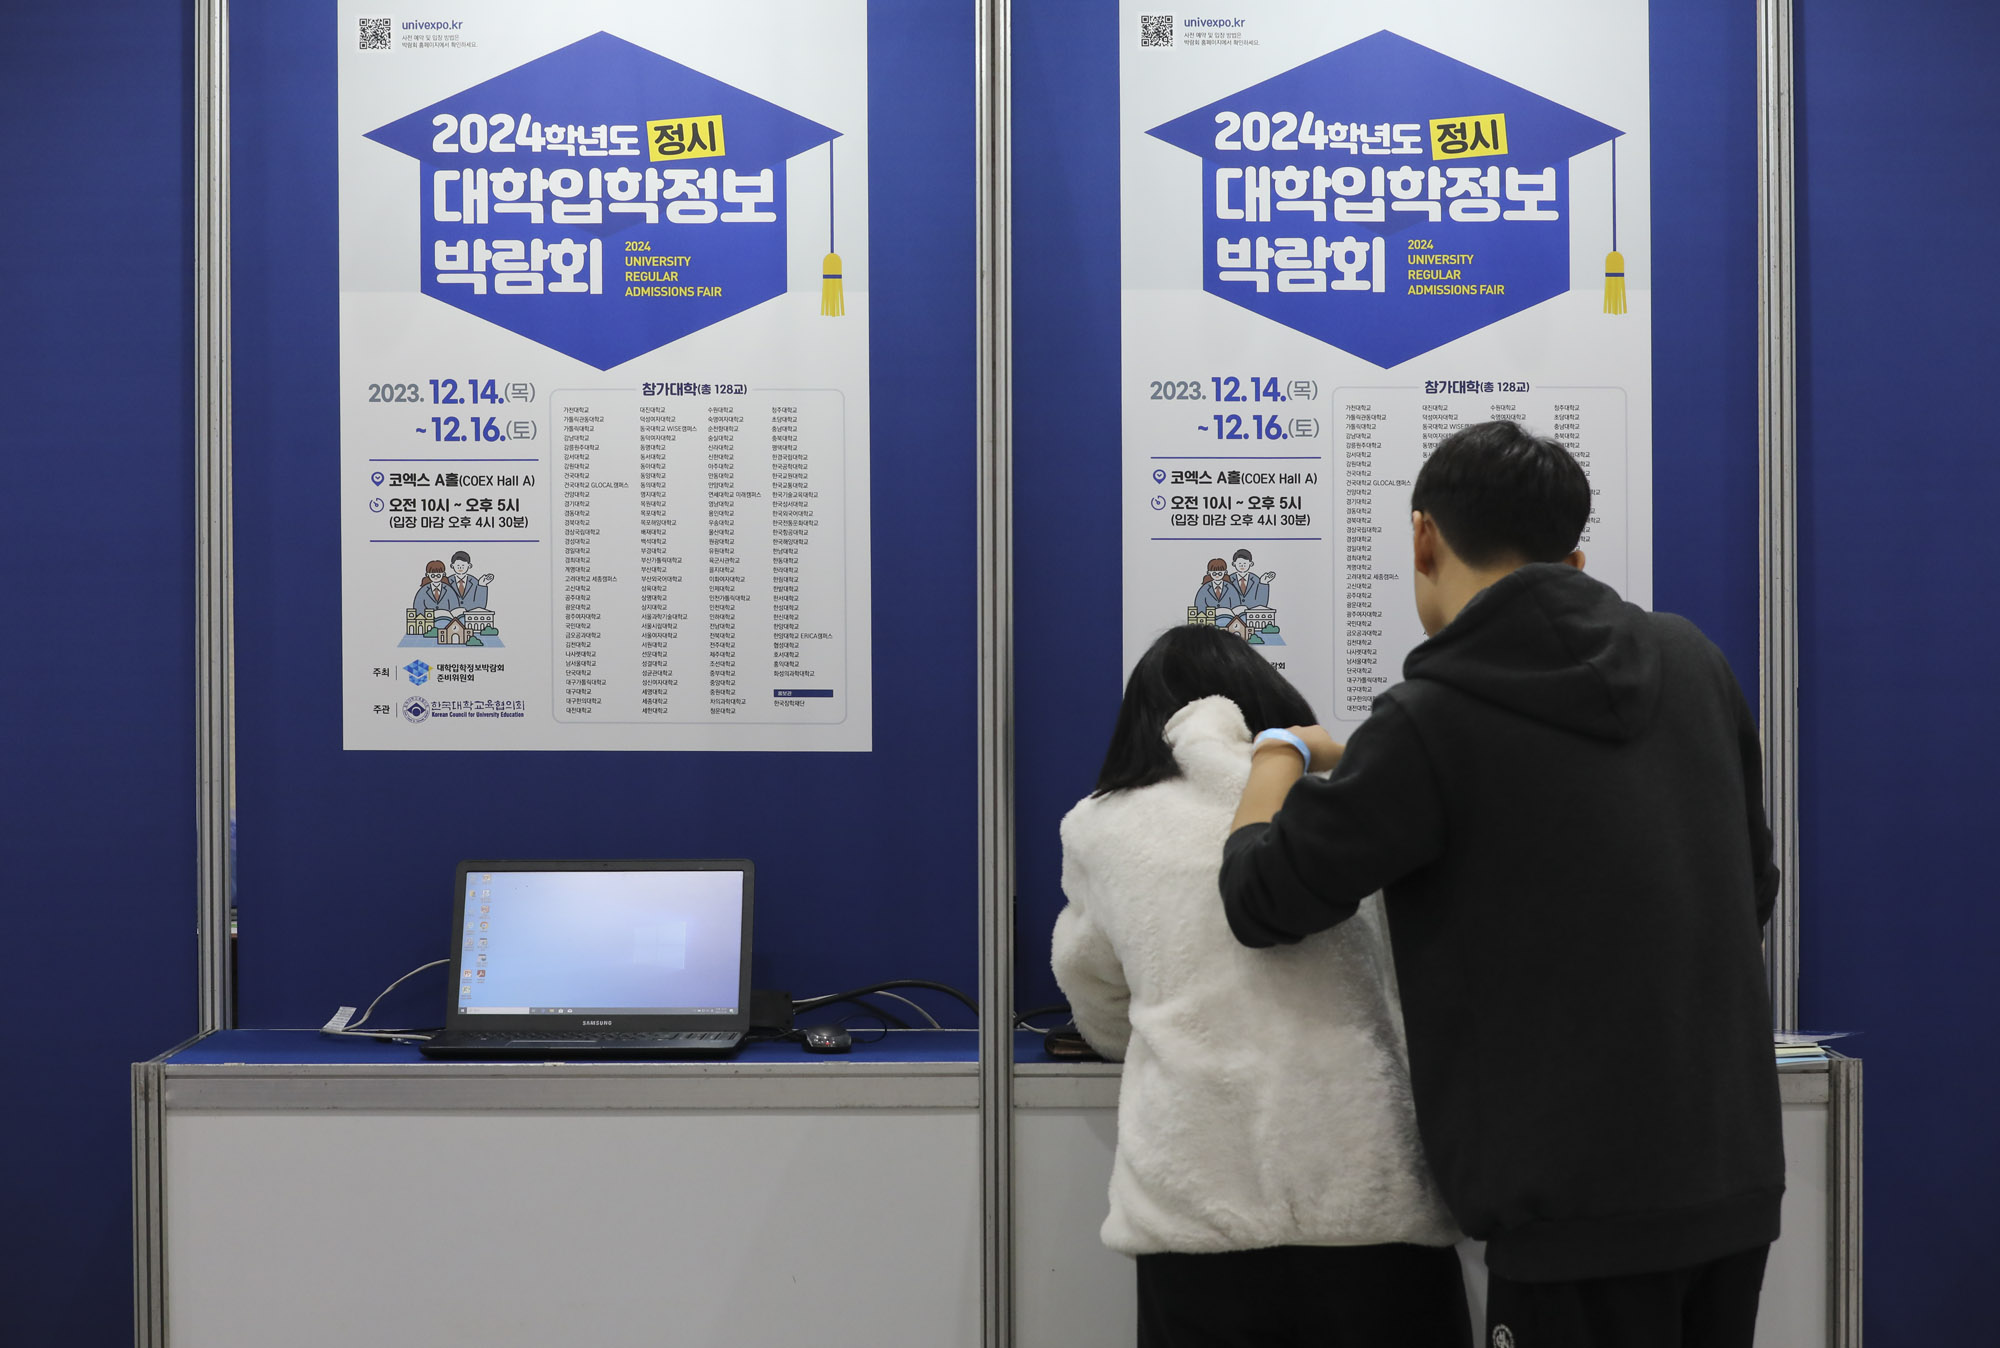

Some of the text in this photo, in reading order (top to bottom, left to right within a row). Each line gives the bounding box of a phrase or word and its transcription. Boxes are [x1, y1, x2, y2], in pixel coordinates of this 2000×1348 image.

[402, 20, 463, 30] univexpo.kr
[1184, 17, 1246, 28] univexpo.kr
[433, 113, 640, 156] 2024학년도
[1215, 111, 1423, 154] 2024학년도
[1437, 120, 1498, 153] 정시
[654, 121, 716, 155] 정시
[434, 167, 776, 224] 대학입학정보
[1216, 166, 1559, 222] 대학입학정보
[625, 241, 651, 251] 2024
[1408, 240, 1433, 249] 2024
[626, 256, 691, 266] UNIVERSITY
[1217, 236, 1385, 292] 박람회
[1408, 255, 1473, 264] UNIVERSITY
[435, 238, 602, 294] 박람회
[626, 272, 678, 281] REGULAR
[1409, 270, 1461, 279] REGULAR
[625, 287, 721, 296] ADMISSIONS FAIR
[1408, 285, 1504, 294] ADMISSIONS FAIR
[642, 382, 747, 396] 참가대학(총 128교)
[1150, 381, 1206, 400] 2023.
[1425, 380, 1530, 394] 참가대학(총 128교)
[369, 384, 424, 402] 2023.
[564, 406, 589, 414] 가천대학교
[640, 406, 665, 414] 대진대학교
[708, 406, 733, 414] 수원대학교
[389, 473, 430, 487] 코엑스
[497, 475, 519, 488] Hall
[522, 475, 535, 487] A)
[1170, 470, 1213, 485] 코엑스
[1279, 473, 1301, 485] Hall
[1305, 473, 1317, 485] A)
[1346, 479, 1371, 487] 건국대학교
[772, 491, 818, 499] 한국기술교육대학교
[389, 497, 416, 512] 오전
[420, 498, 449, 512] 10시
[465, 497, 494, 513] 오후
[496, 497, 519, 513] 5시
[565, 500, 589, 508] 경기대학교
[1171, 496, 1199, 512] 오전
[1203, 496, 1231, 511] 10시
[1248, 496, 1275, 511] 오후
[1279, 496, 1301, 512] 5시
[389, 515, 528, 528] (입장 마감 오후 4시 30분)
[1171, 513, 1310, 526] (입장 마감 오후 4시 30분)
[773, 538, 808, 546] 한국해양대학교
[1346, 573, 1372, 581] 고려대학교
[565, 594, 591, 602] 공주대학교
[373, 668, 389, 677] 주최
[437, 664, 504, 673] 대학입학정보박람회
[566, 669, 592, 677] 단국대학교
[642, 669, 672, 677] 성균관대학교
[437, 674, 474, 682] 준비위원회
[373, 705, 390, 714] 주관
[431, 699, 525, 711] 한국대학교육협의회
